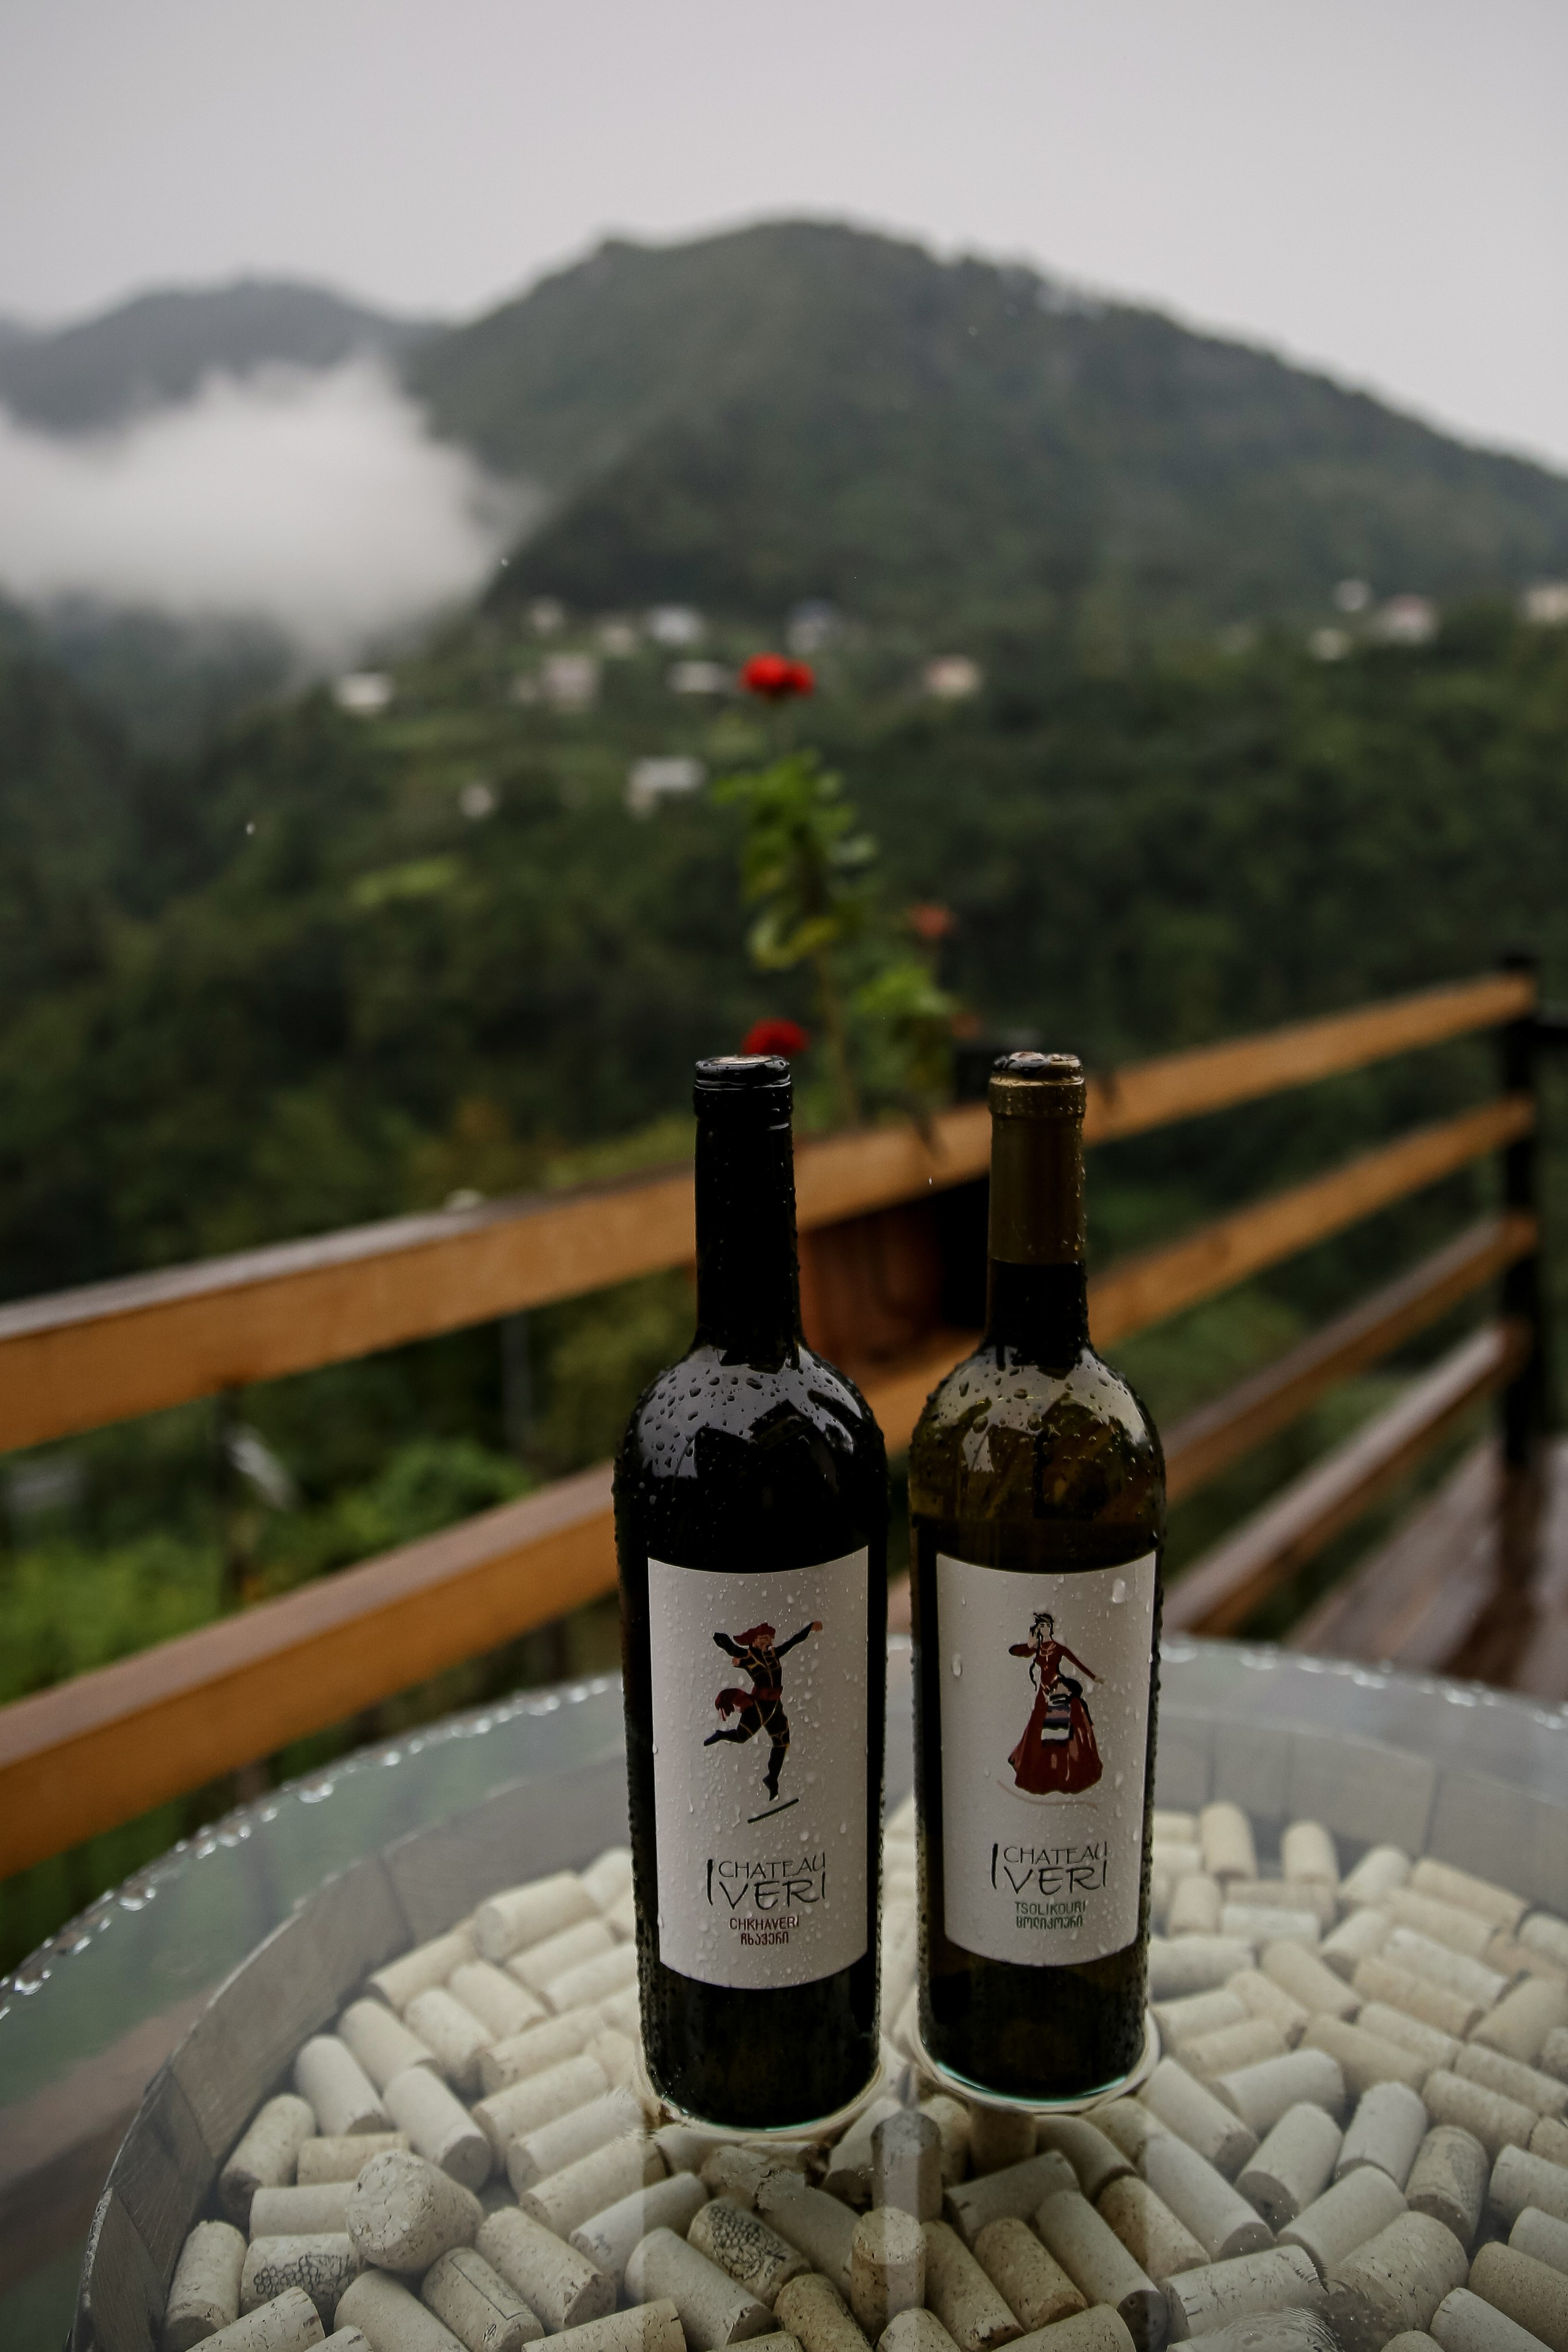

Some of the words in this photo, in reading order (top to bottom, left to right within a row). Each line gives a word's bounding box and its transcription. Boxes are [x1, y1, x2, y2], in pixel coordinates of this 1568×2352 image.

[1003, 1841, 1107, 1864] CHATEAU
[718, 1852, 826, 1879] CHATEAU
[1015, 1901, 1085, 1915] TSOLIKOURI
[729, 1915, 799, 1930] CHKHAVERI
